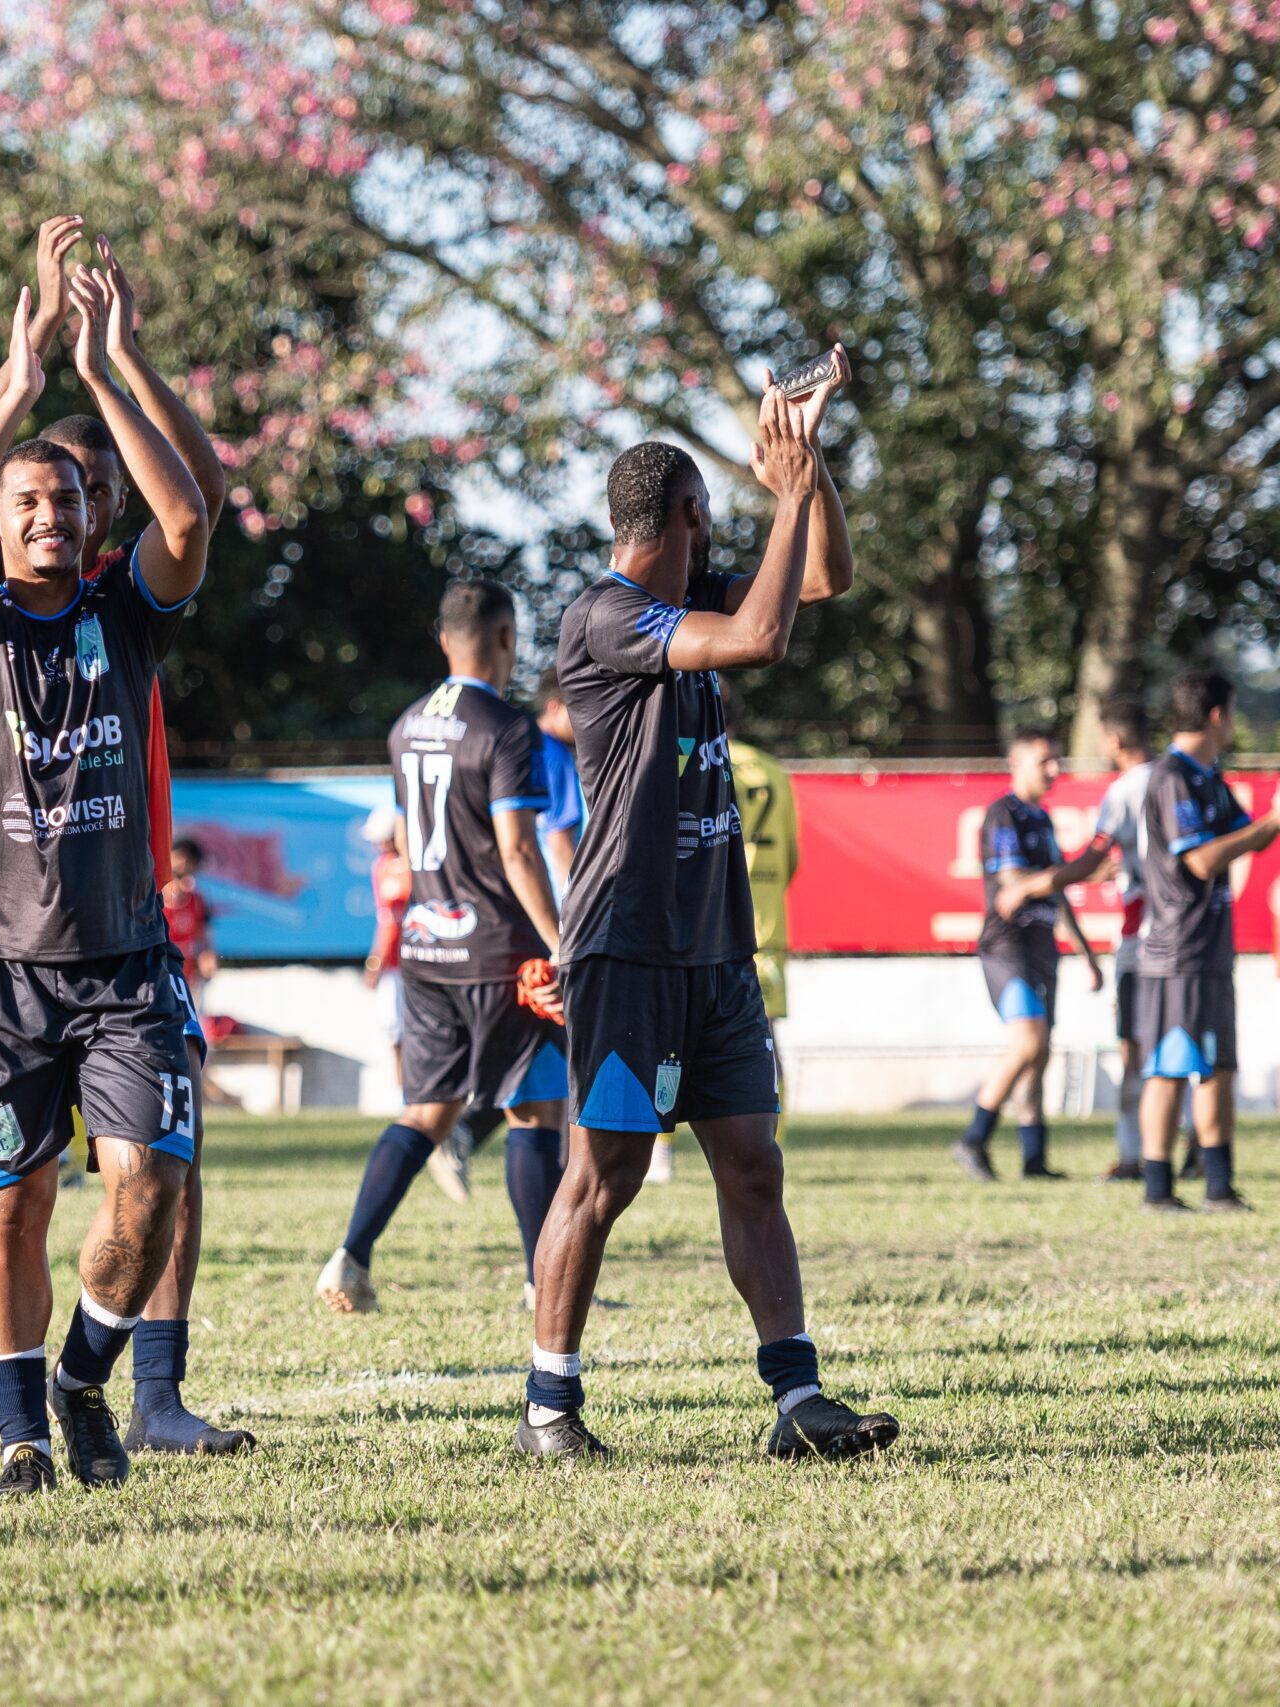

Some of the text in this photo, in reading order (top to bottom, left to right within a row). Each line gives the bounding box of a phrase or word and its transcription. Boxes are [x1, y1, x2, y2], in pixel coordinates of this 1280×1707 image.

[24, 714, 122, 764] SICOOB
[78, 748, 124, 771] ale Sul
[108, 815, 126, 830] NET
[401, 752, 453, 871] 17
[159, 1071, 194, 1140] 13
